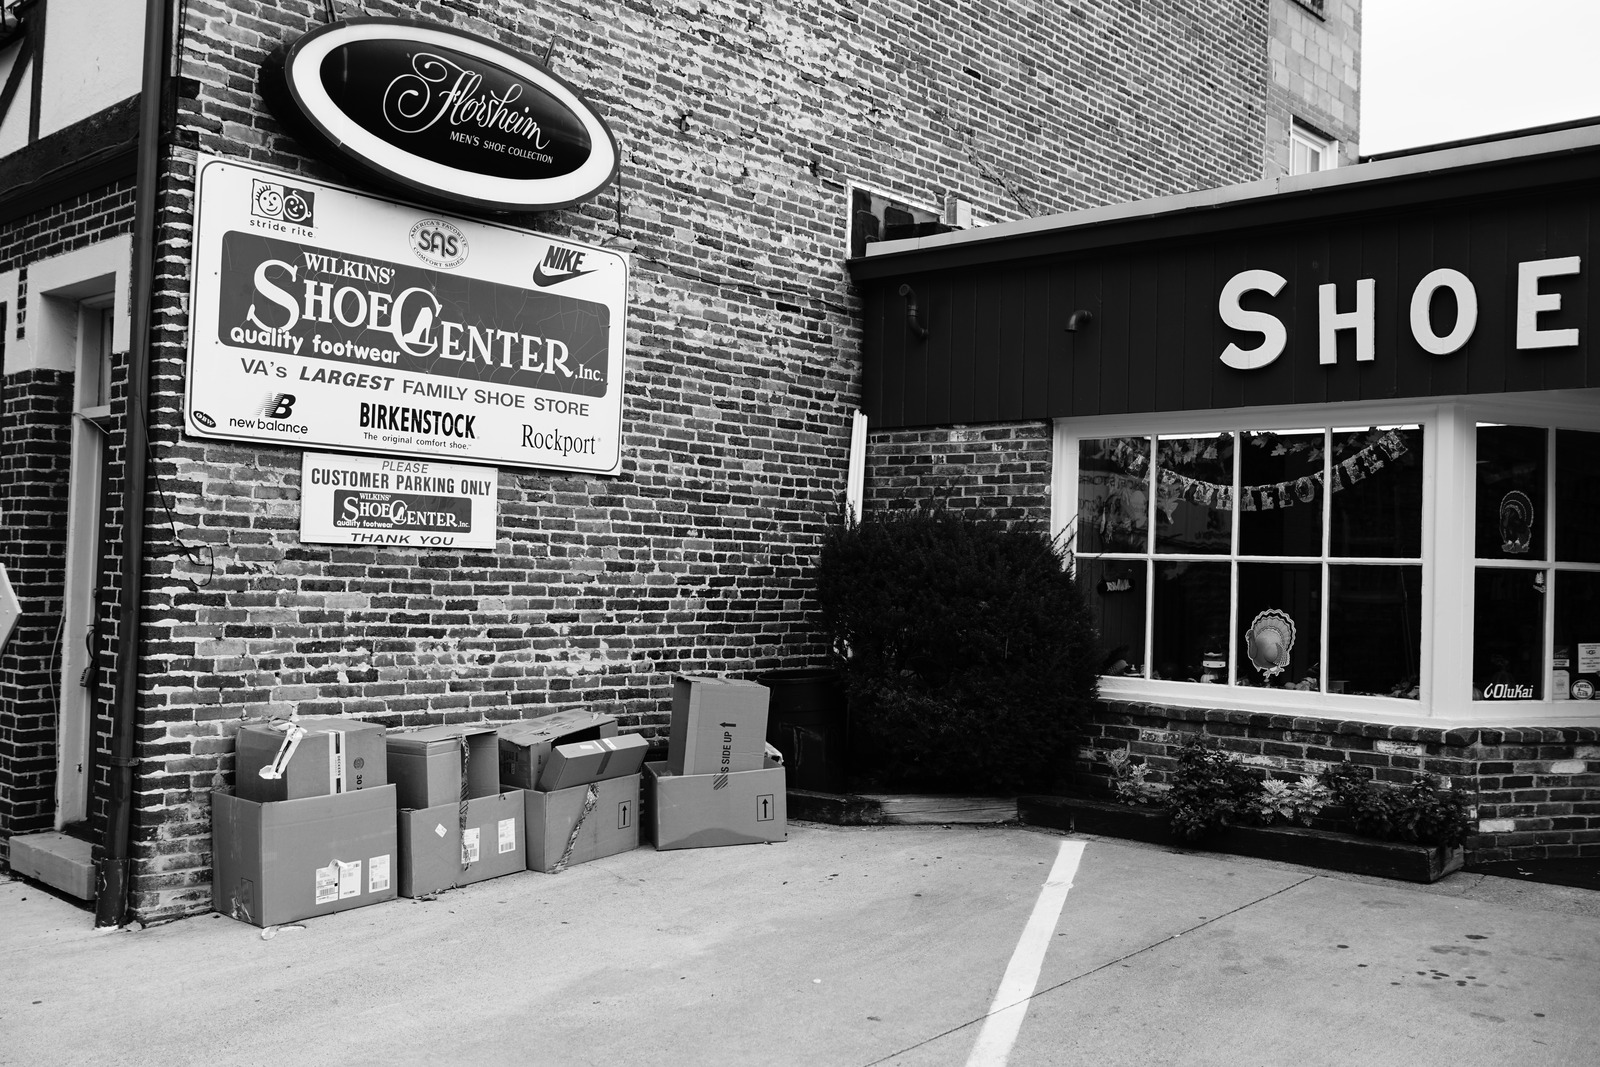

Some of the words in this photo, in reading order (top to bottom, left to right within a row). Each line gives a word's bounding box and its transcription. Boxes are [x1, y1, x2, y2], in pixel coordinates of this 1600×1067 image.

[383, 53, 550, 149] Florsheim
[449, 131, 480, 147] MEN'S
[483, 139, 505, 154] SHOE
[508, 146, 554, 164] COLLECTION
[249, 219, 287, 233] stride
[291, 227, 313, 238] rite
[418, 229, 458, 258] SAS
[303, 251, 396, 285] WILKINS'
[542, 244, 586, 273] NIKE
[246, 259, 394, 333] SHOE
[1219, 255, 1580, 370] SHOE
[312, 334, 400, 364] footwear
[241, 357, 287, 378] VA's
[299, 366, 395, 391] LARGEST
[402, 379, 468, 401] FAMILY
[474, 389, 525, 409] SHOE
[533, 397, 589, 417] STORE
[229, 417, 255, 429] new
[257, 418, 308, 434] balance
[360, 402, 476, 439] BIRKENSTOCK
[363, 432, 378, 440] The
[382, 434, 412, 444] original
[416, 438, 446, 448] comfort
[521, 424, 595, 457] Rockport
[381, 460, 429, 474] PLEASE
[311, 468, 389, 489] CUSTOMER
[396, 475, 454, 494] PARKING
[461, 479, 491, 496] ONLY
[359, 493, 391, 501] WILKINS'
[363, 520, 393, 528] footwear
[351, 533, 410, 544] THANK
[420, 536, 454, 546] YOU
[723, 731, 732, 743] UP
[721, 745, 731, 765] SIDE
